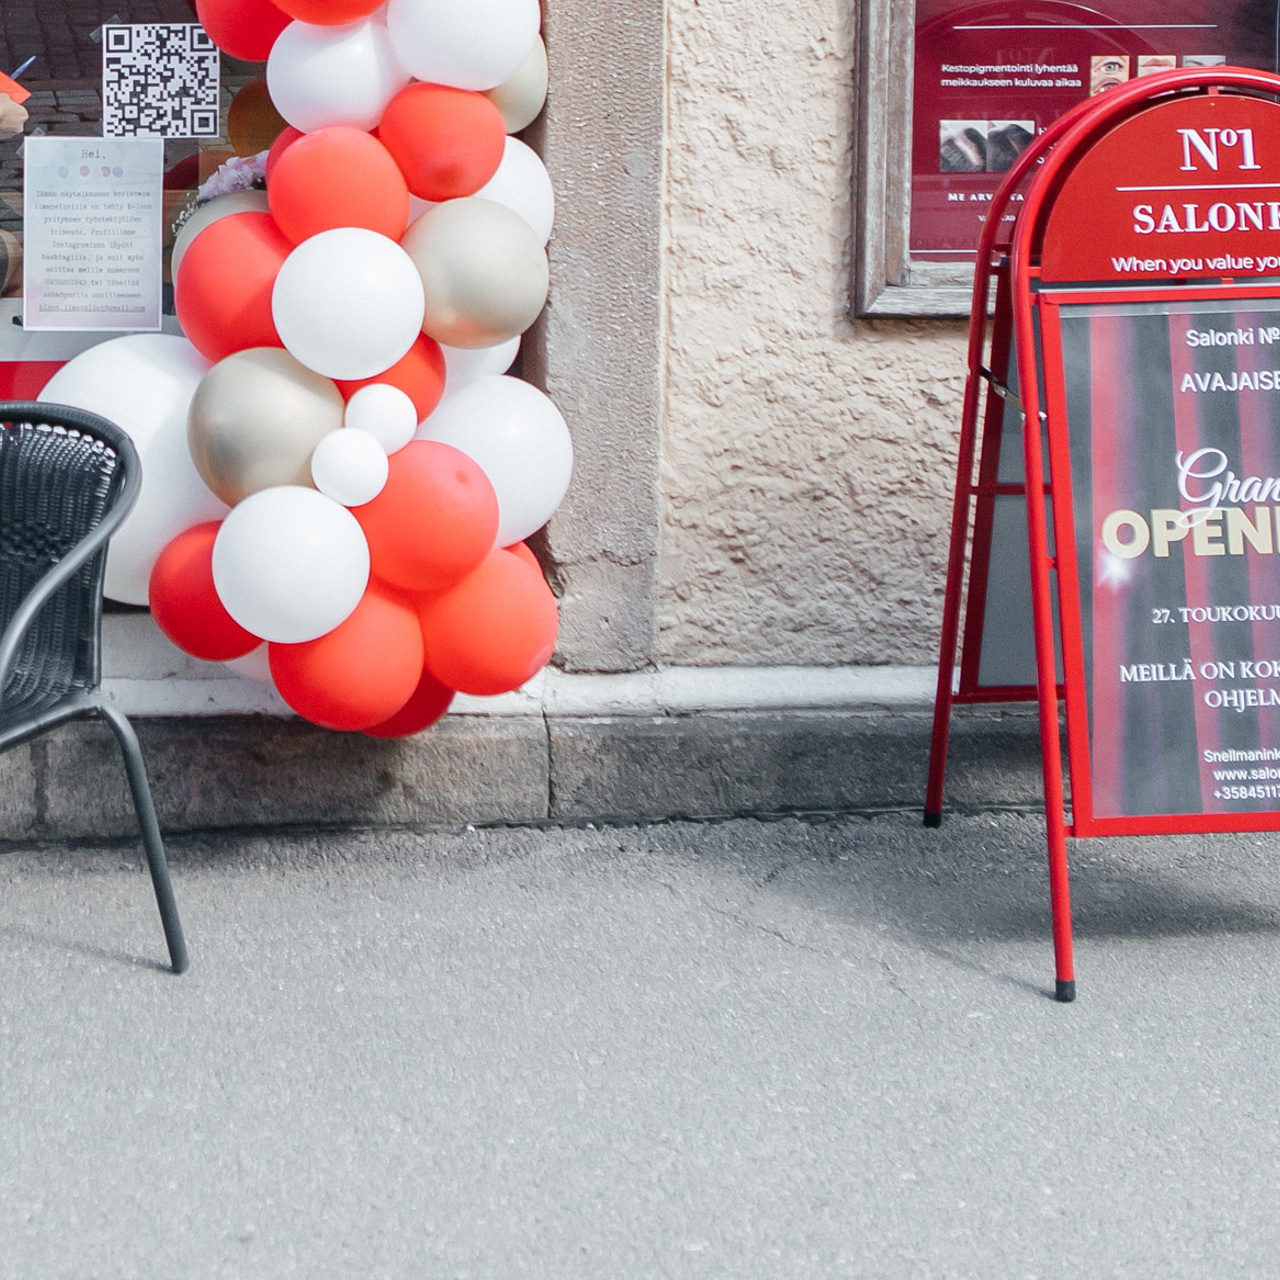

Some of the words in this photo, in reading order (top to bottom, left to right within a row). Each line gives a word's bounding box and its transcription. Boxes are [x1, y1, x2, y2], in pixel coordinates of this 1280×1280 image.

[941, 63, 1034, 75] Kestopigmentointi
[1034, 63, 1079, 75] lyhentää
[940, 77, 1014, 87] meikkaukseen
[1013, 77, 1054, 87] kuluvaa
[1054, 77, 1082, 88] aikaa
[947, 192, 965, 202] ME
[1111, 256, 1167, 272] When
[1169, 258, 1203, 275] you
[1205, 253, 1255, 270] value
[1255, 256, 1280, 272] yo
[1185, 327, 1255, 347] Salonki
[1151, 608, 1176, 624] 27.
[1119, 658, 1198, 683] MEILLÄ
[1199, 661, 1235, 680] ON
